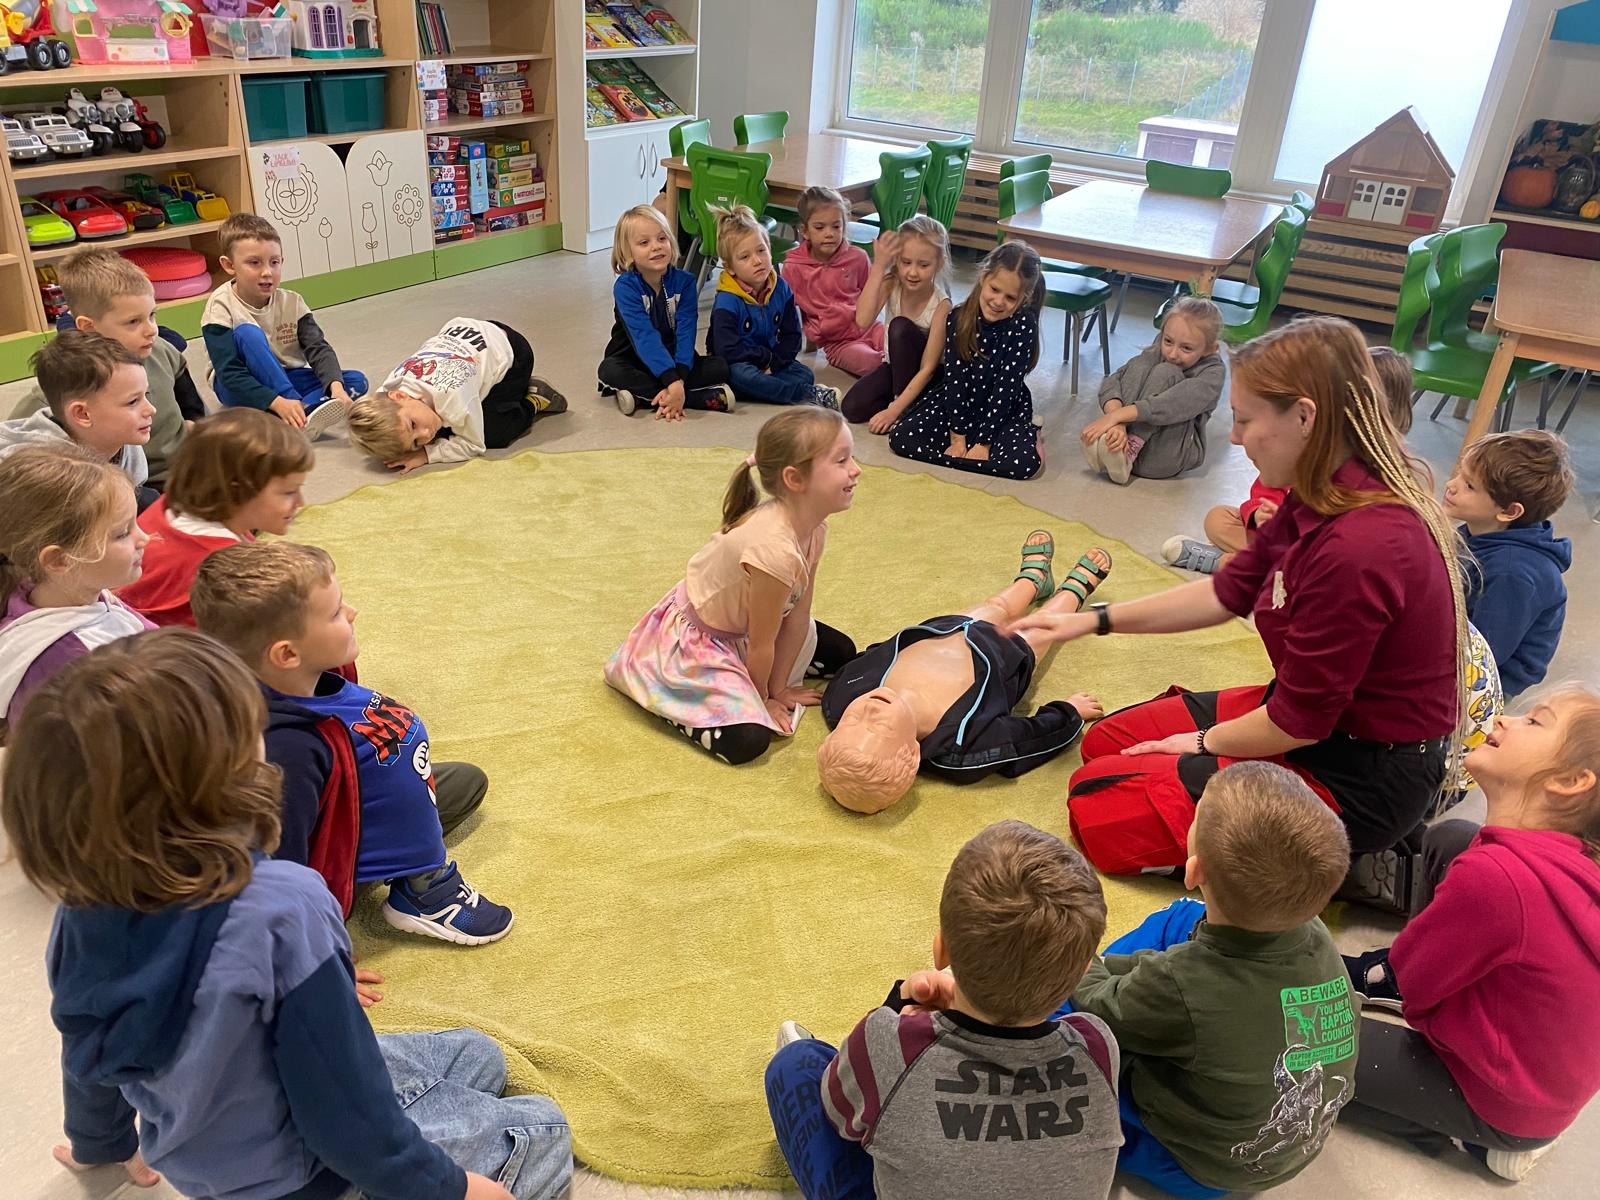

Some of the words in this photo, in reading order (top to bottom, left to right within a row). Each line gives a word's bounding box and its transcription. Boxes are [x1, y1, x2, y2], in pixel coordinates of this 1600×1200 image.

[1300, 977, 1347, 1003] BEWARE
[1319, 1003, 1333, 1016] YOU
[1334, 999, 1345, 1013] ARE
[1320, 1008, 1353, 1031] RAPTOR
[935, 1055, 1088, 1096] STAR
[936, 1095, 1090, 1142] WARS
